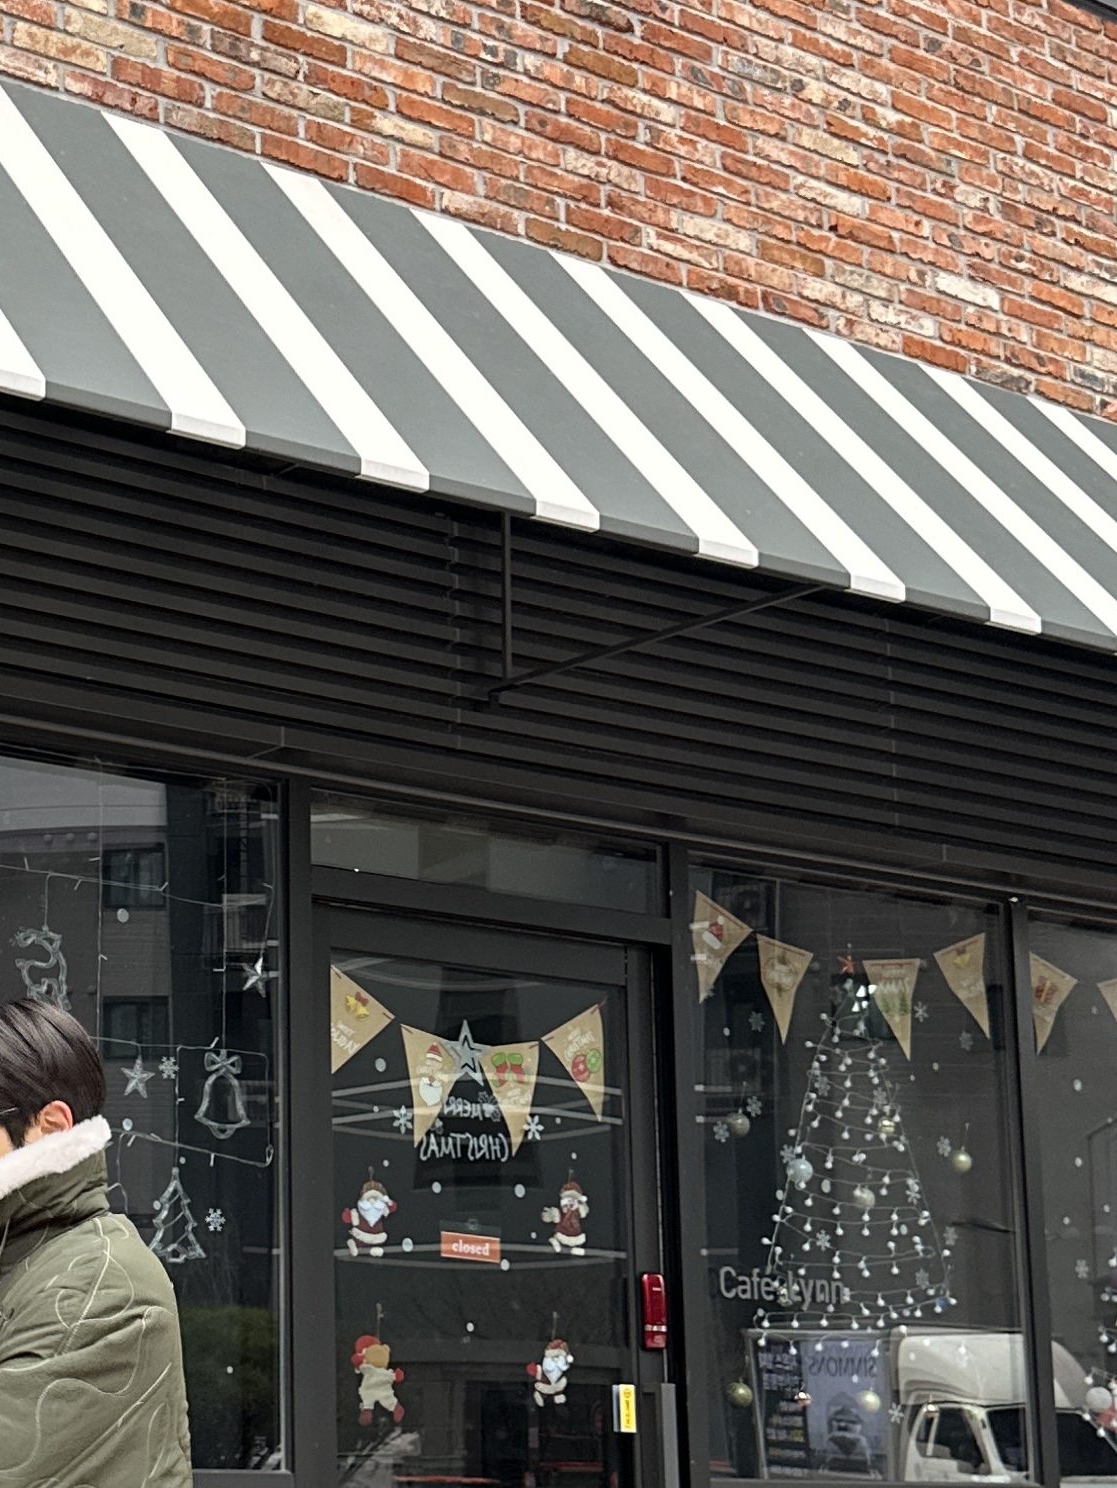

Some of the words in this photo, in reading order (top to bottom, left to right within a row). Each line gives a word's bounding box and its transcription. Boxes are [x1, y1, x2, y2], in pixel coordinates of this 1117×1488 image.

[451, 1238, 490, 1256] closed
[718, 1265, 775, 1302] Cafe
[787, 1270, 845, 1312] Lynn
